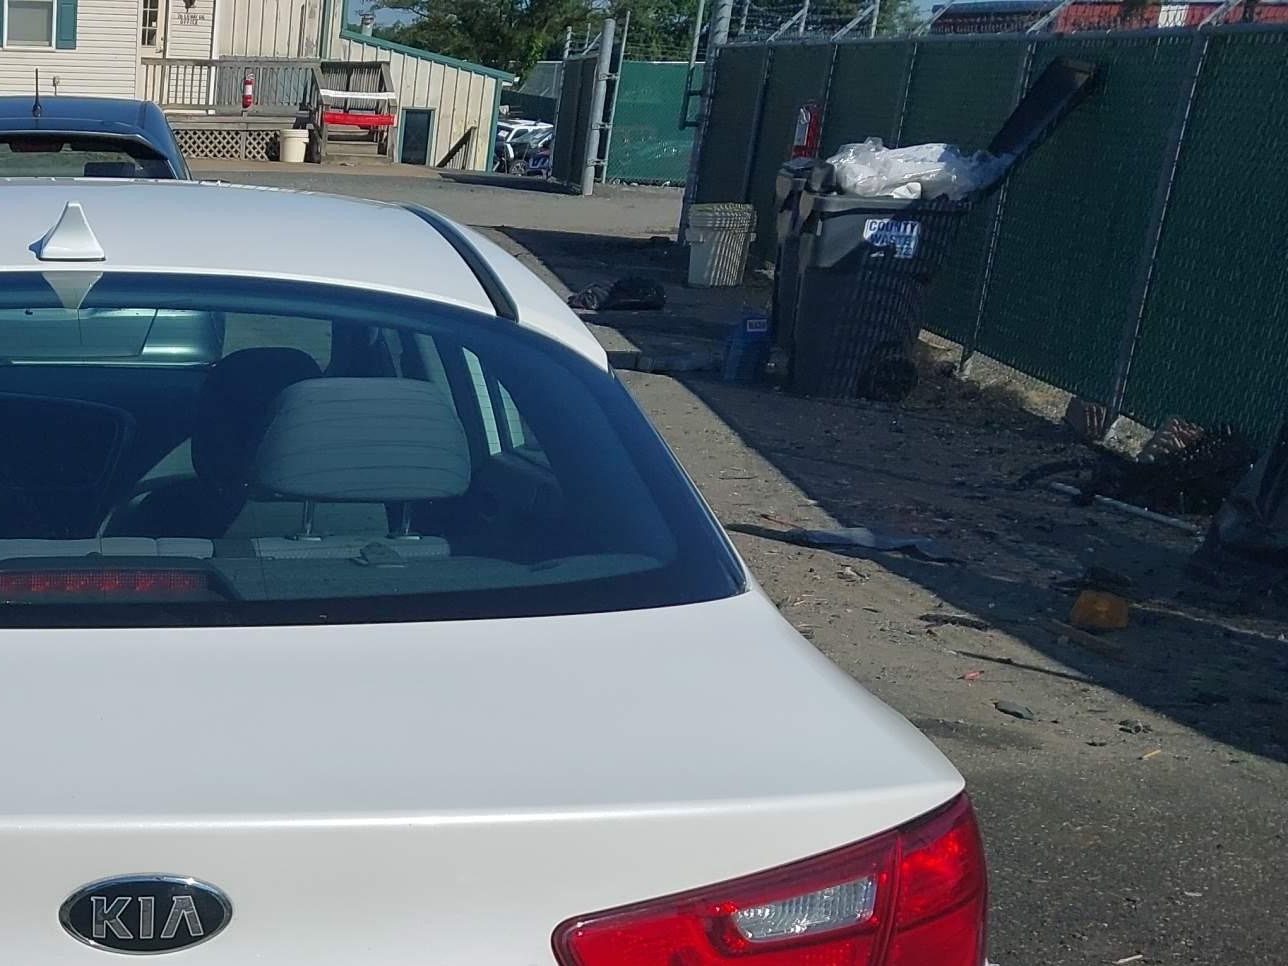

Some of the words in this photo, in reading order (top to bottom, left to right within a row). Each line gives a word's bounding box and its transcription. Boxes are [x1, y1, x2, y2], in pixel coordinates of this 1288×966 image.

[869, 221, 918, 235] COUNTY
[871, 233, 914, 248] WASTE
[91, 895, 205, 940] KIA
